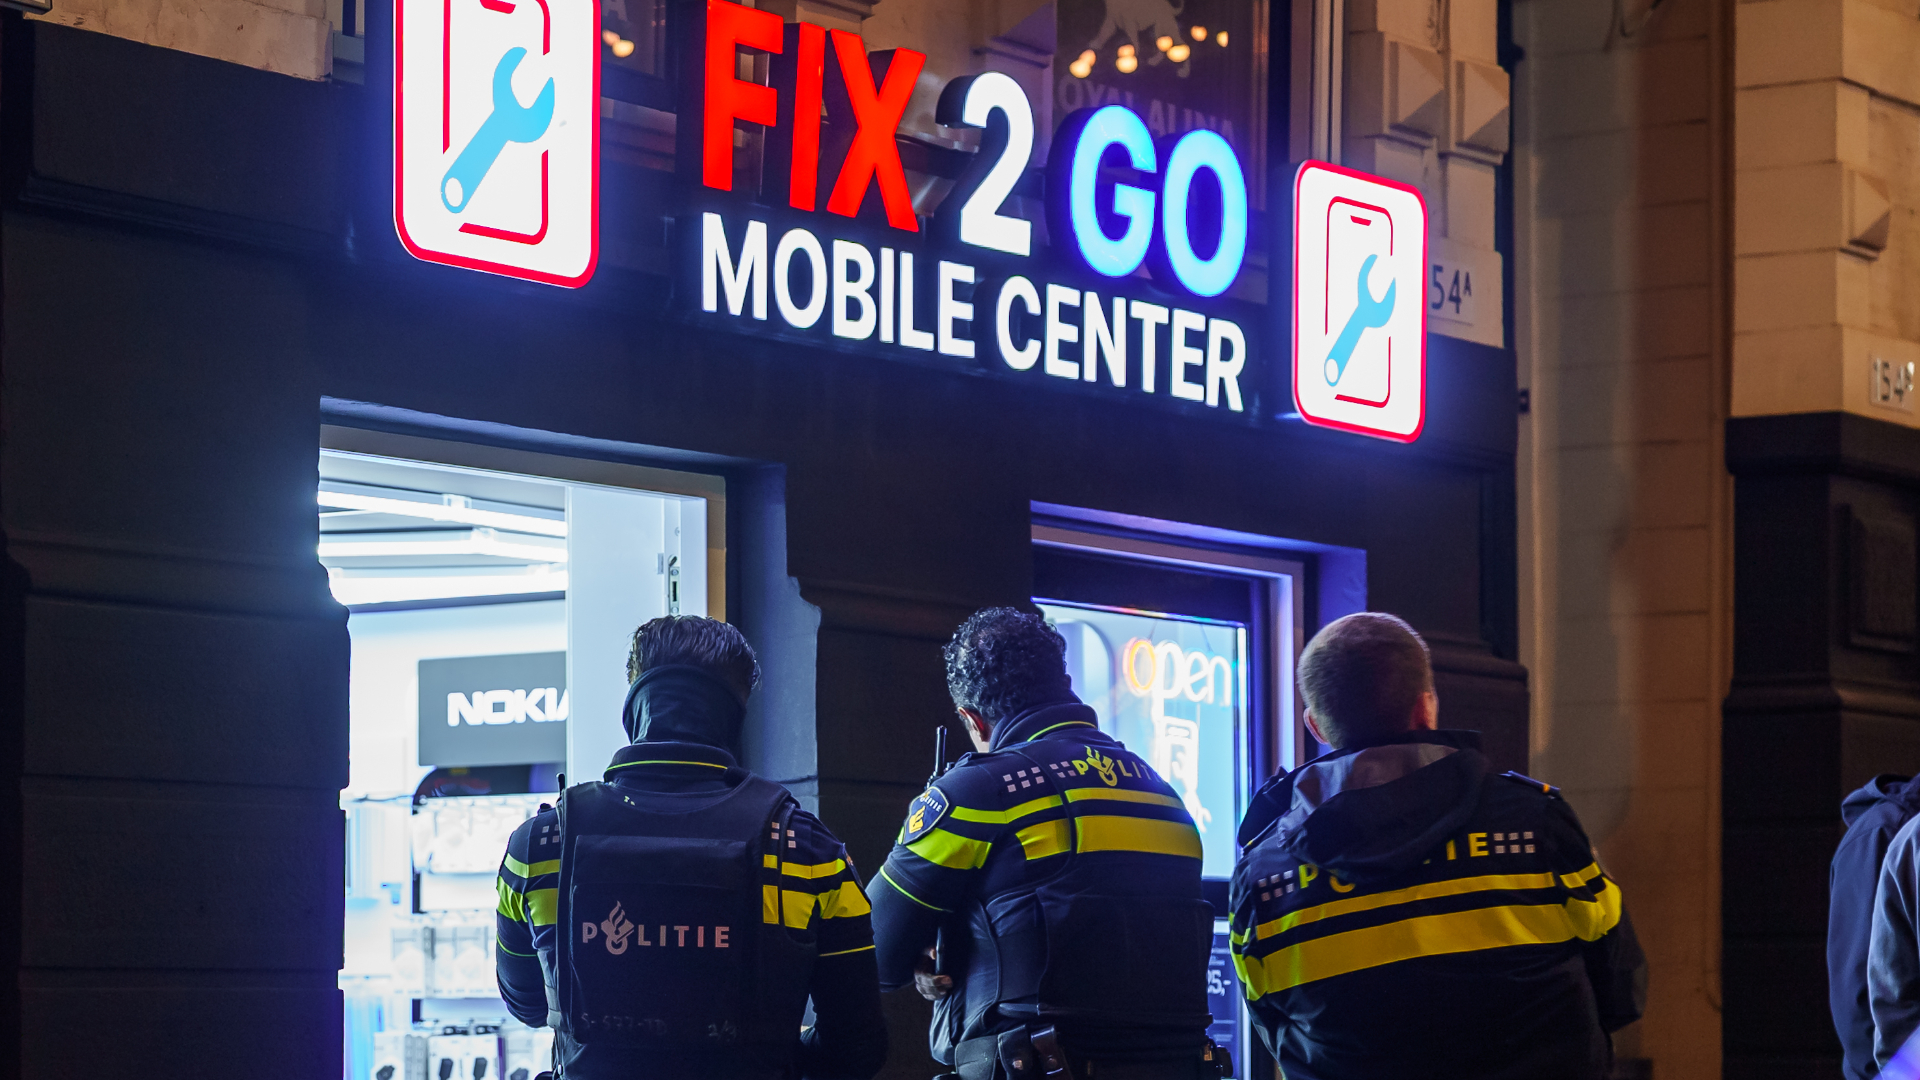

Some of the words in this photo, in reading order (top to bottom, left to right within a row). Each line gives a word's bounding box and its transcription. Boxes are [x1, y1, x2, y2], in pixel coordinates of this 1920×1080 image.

[702, 0, 926, 232] FIX
[938, 71, 1035, 256] 2
[1068, 104, 1248, 298] GO
[701, 212, 976, 359] MOBILE
[995, 275, 1247, 412] CENTER
[1124, 637, 1232, 714] open
[582, 907, 731, 955] POLITIE
